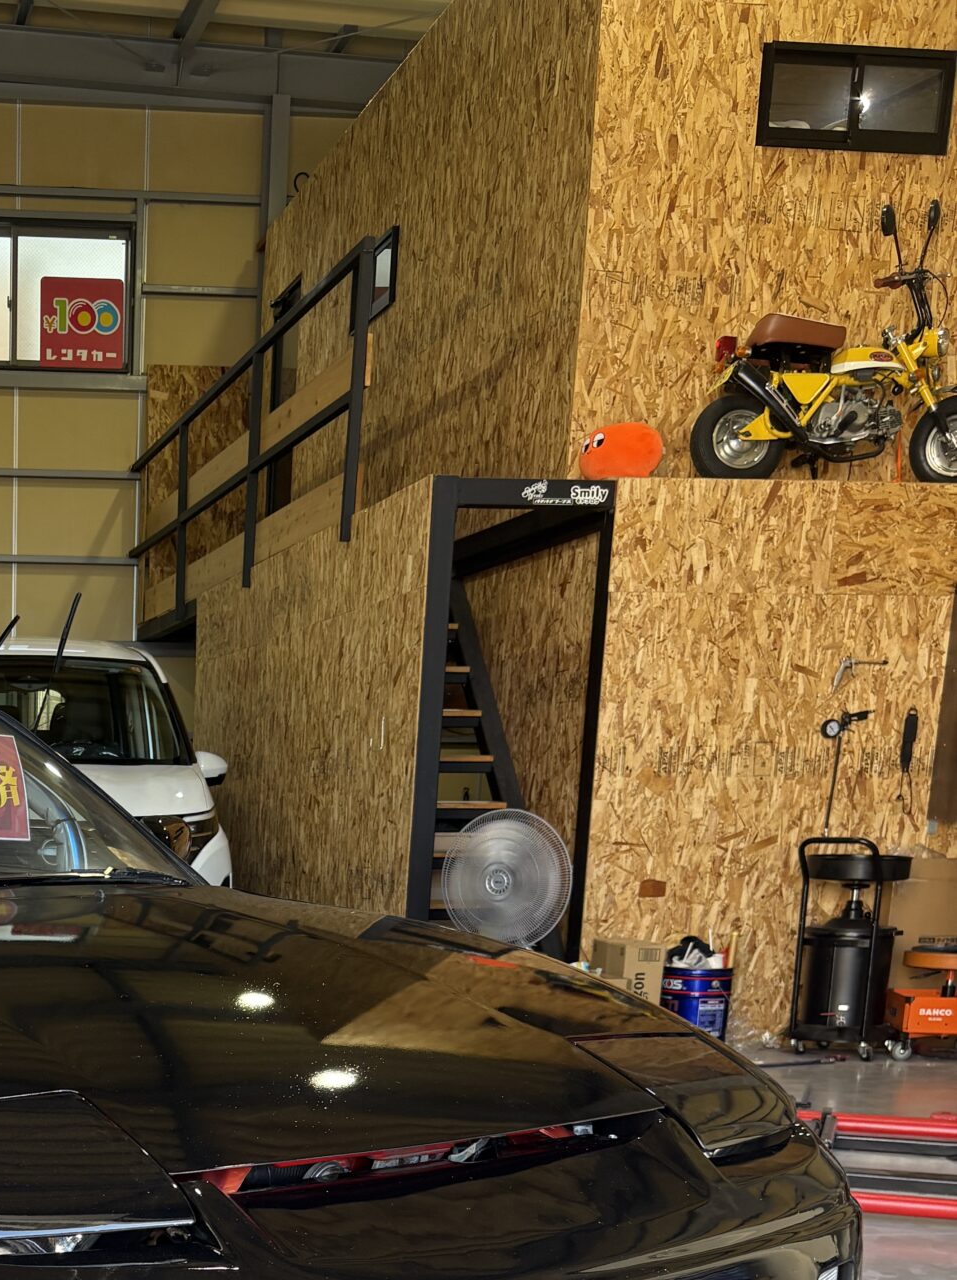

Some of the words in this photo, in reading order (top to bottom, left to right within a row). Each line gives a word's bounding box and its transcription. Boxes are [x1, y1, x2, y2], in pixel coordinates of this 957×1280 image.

[45, 348, 118, 362] レンタカー
[571, 486, 608, 502] Smily
[919, 1008, 952, 1017] BAHCO
